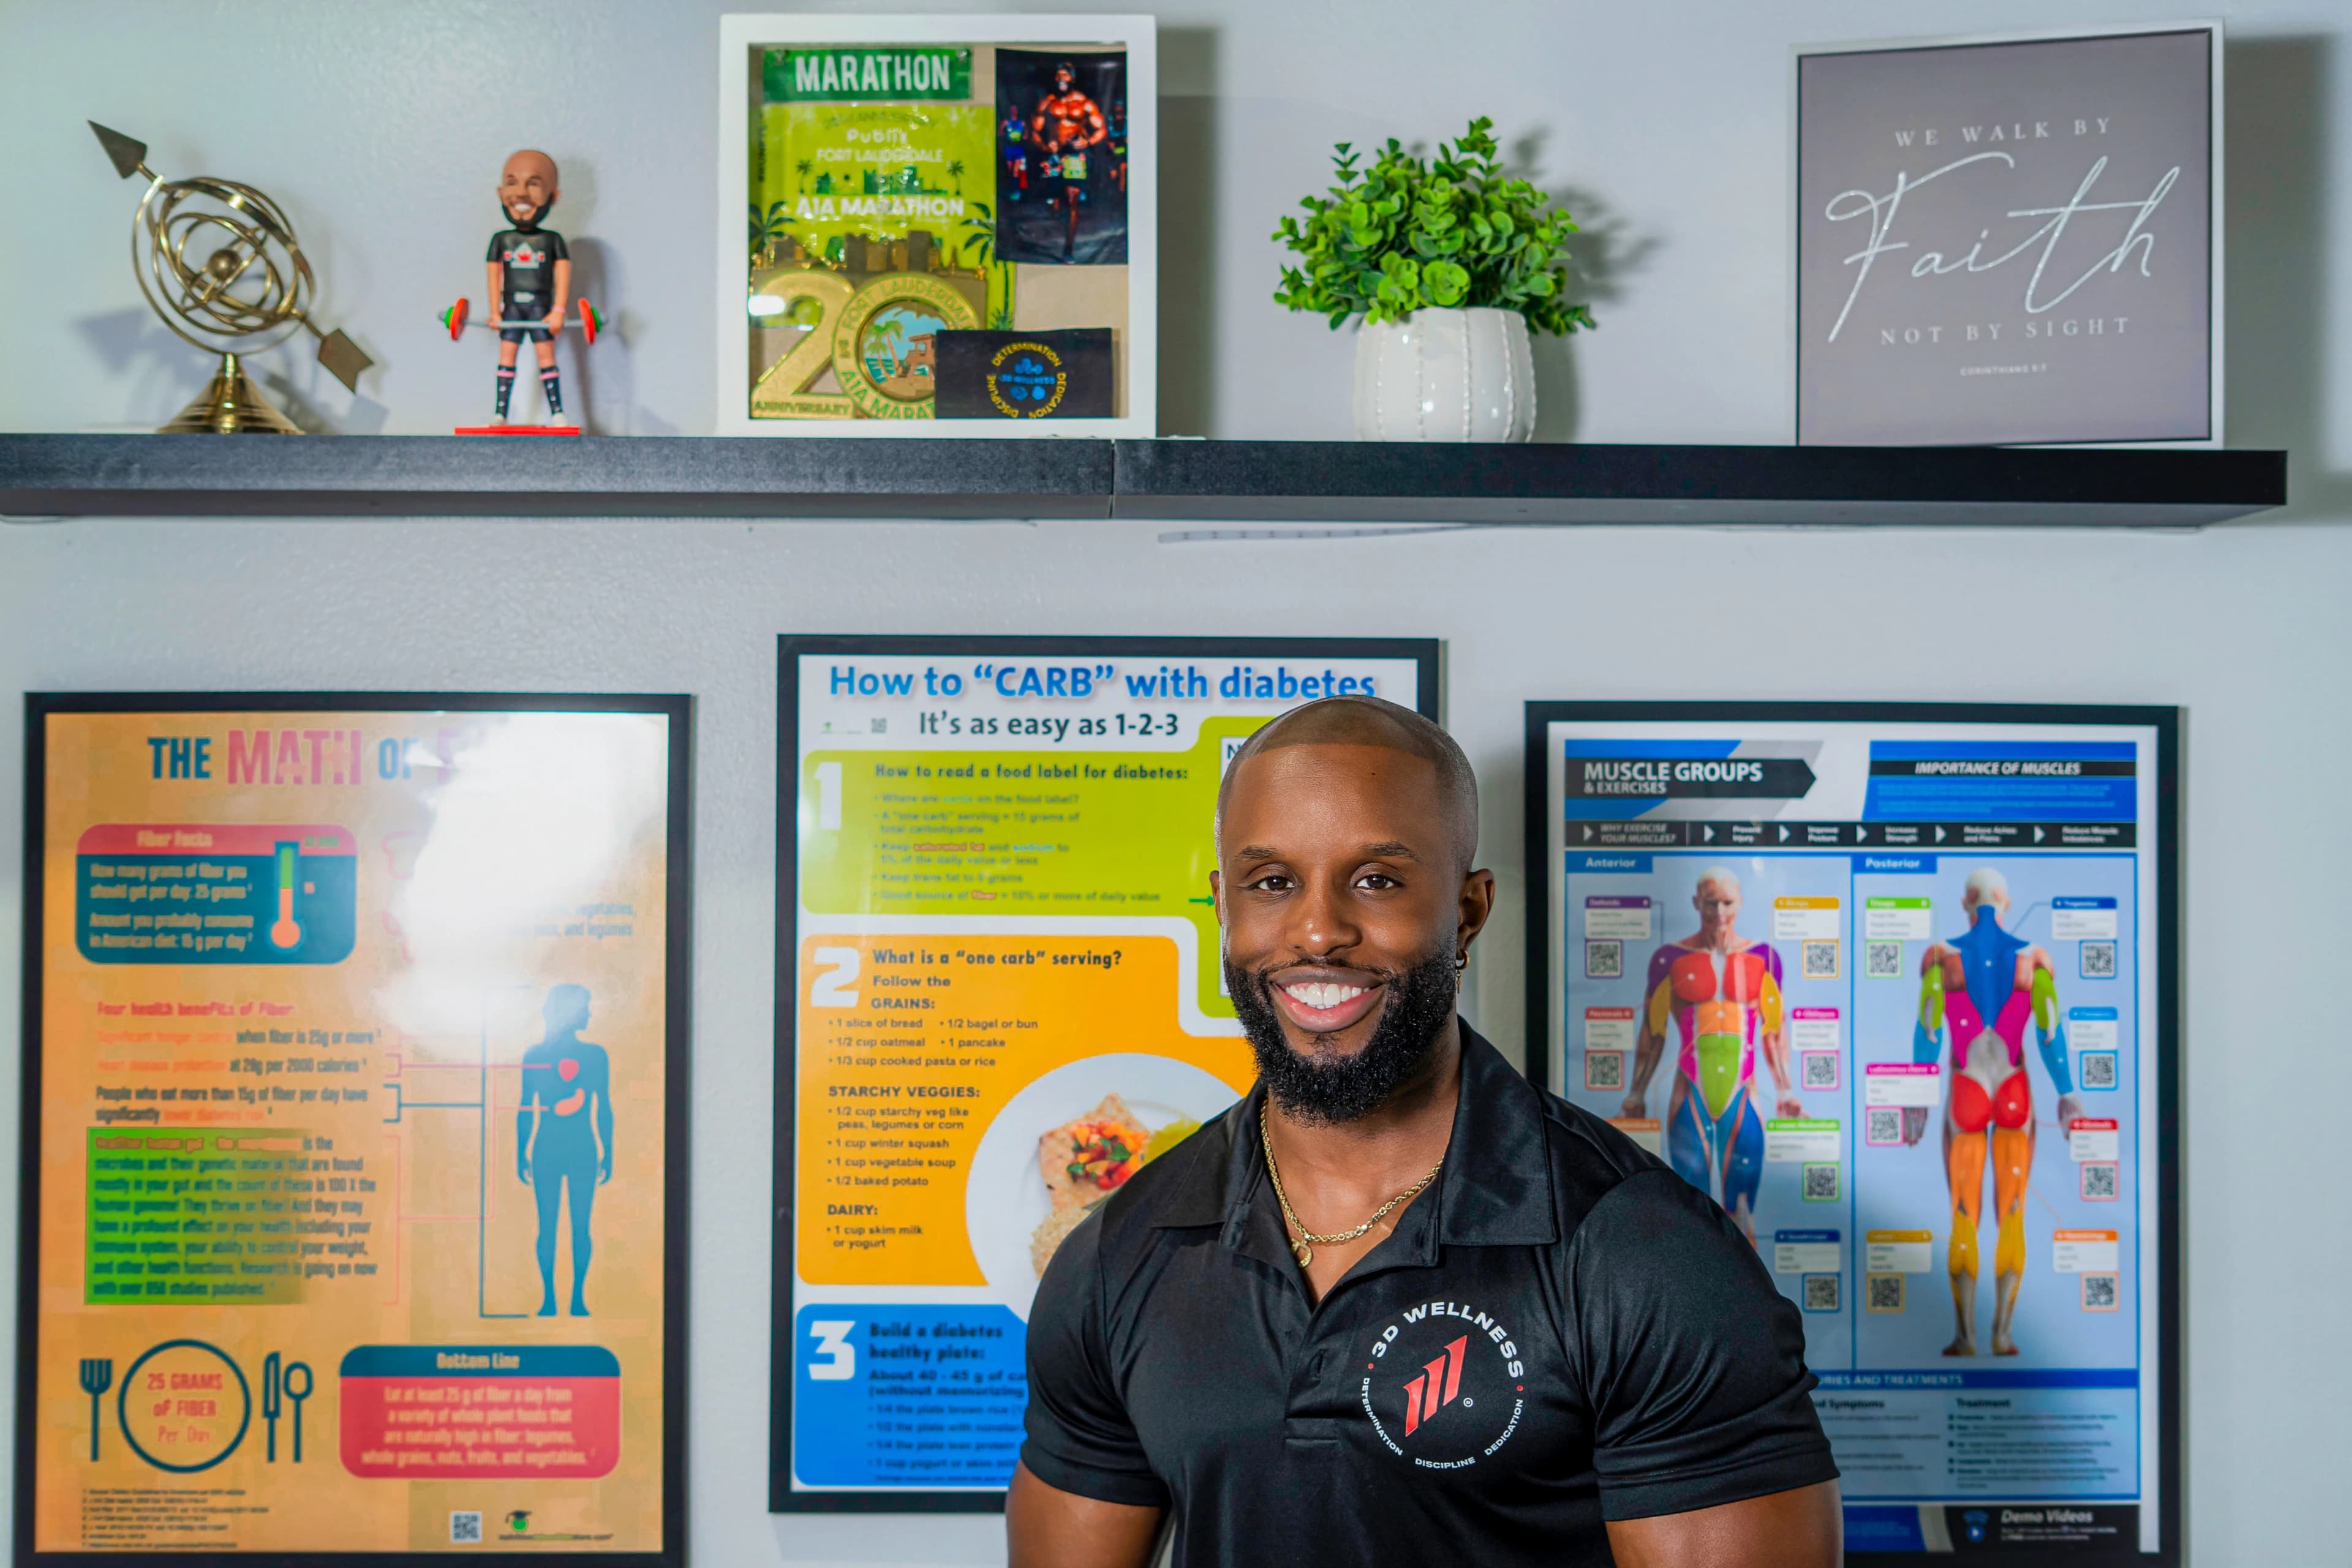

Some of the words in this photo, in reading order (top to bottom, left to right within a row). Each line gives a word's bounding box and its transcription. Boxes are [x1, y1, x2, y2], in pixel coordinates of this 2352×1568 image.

[796, 55, 949, 92] MARATHON
[1896, 130, 1937, 147] WE
[1962, 123, 2048, 142] WALK
[2075, 118, 2109, 135] BY
[816, 148, 853, 162] FORT
[841, 196, 963, 216] MARATHON
[1825, 151, 2181, 344] Faith
[842, 290, 876, 330] FORT
[1882, 327, 1941, 345] NOT
[1967, 324, 2000, 341] BY
[2026, 318, 2127, 337] SIGHT
[991, 342, 1062, 367] DETERMINATION
[986, 374, 1019, 418] DISCIPLINE
[1028, 371, 1067, 418] DEDICATION
[754, 401, 850, 415] ANNIVERSARY
[831, 666, 913, 695] How
[924, 667, 962, 696] to
[1125, 664, 1209, 699] with
[1219, 665, 1376, 699] diabetes
[971, 718, 998, 734] as
[1008, 718, 1069, 742] easy
[1079, 719, 1106, 735] as
[1115, 712, 1179, 737] 1-2-3
[147, 737, 211, 778] THE
[226, 729, 362, 785] MATH
[875, 764, 909, 777] How
[916, 765, 932, 778] to
[938, 764, 974, 778] read
[981, 768, 990, 778] a
[997, 764, 1031, 778] food
[1038, 764, 1077, 778] label
[1084, 764, 1106, 778] for
[1114, 764, 1187, 778] diabetes:
[1585, 763, 1670, 781] MUSCLE
[1675, 763, 1762, 782] GROUPS
[1914, 762, 1999, 774] IMPORTANCE
[2000, 762, 2021, 775] OF
[2021, 762, 2082, 775] MUSCLES
[1584, 782, 1594, 793] &
[1597, 782, 1668, 794] EXERCISES
[813, 761, 843, 831] 1
[1600, 824, 1624, 834] WHY
[1624, 824, 1668, 834] EXERCISE
[1601, 834, 1629, 843] YOUR
[1627, 834, 1676, 843] MUSCLES?
[1586, 858, 1635, 867] Anterior
[1866, 858, 1920, 868] Posterior
[873, 949, 914, 963] What
[921, 949, 933, 964] is
[940, 954, 949, 964] a
[1051, 949, 1123, 970] serving?
[810, 946, 861, 1008] 2
[872, 975, 921, 986] Follow
[927, 976, 951, 986] the
[871, 998, 935, 1009] GRAINS:
[846, 1019, 872, 1027] slice
[876, 1019, 888, 1028] of
[890, 1019, 922, 1028] bread
[948, 1019, 963, 1028] 1/2
[967, 1019, 998, 1031] bagel
[1016, 1019, 1038, 1029] bun
[837, 1037, 853, 1047] 1/2
[856, 1039, 878, 1049] cup
[880, 1038, 925, 1047] oatmeal
[949, 1038, 954, 1047] 1
[958, 1038, 1006, 1049] pancake
[854, 1057, 877, 1067] cup
[880, 1057, 922, 1066] cooked
[924, 1058, 956, 1068] pasta
[829, 1086, 900, 1097] STARCHY
[907, 1087, 979, 1098] VEGGIES:
[855, 1108, 877, 1119] cup
[880, 1107, 921, 1118] starchy
[925, 1109, 946, 1118] veg
[949, 1107, 968, 1116] like
[838, 1121, 867, 1130] peas,
[872, 1120, 919, 1131] legumes
[845, 1140, 867, 1150] cup
[870, 1139, 904, 1148] winter
[908, 1139, 949, 1150] squash
[844, 1159, 866, 1168] cup
[870, 1158, 924, 1169] vegetable
[927, 1159, 956, 1169] soup
[854, 1176, 889, 1186] baked
[892, 1177, 929, 1187] potato
[827, 1204, 877, 1215] DAIRY:
[843, 1227, 865, 1235] cup
[869, 1226, 895, 1235] skim
[899, 1226, 922, 1234] milk
[833, 1239, 845, 1248] or
[848, 1239, 886, 1250] yogurt
[870, 1324, 910, 1337] Build
[933, 1324, 1001, 1337] diabetes
[1371, 1324, 1400, 1358] 3D
[1402, 1301, 1525, 1378] WELLNESS
[808, 1320, 856, 1381] 3
[870, 1345, 930, 1362] healthy
[938, 1345, 985, 1362] plate:
[153, 1399, 172, 1417] of
[176, 1399, 216, 1417] FIBER
[1361, 1377, 1404, 1457] DETERMINATION
[1483, 1398, 1524, 1457] DEDICATION
[1414, 1456, 1477, 1469] DISCIPLINE
[2001, 1510, 2043, 1523] Demo
[2047, 1510, 2093, 1523] Videos
